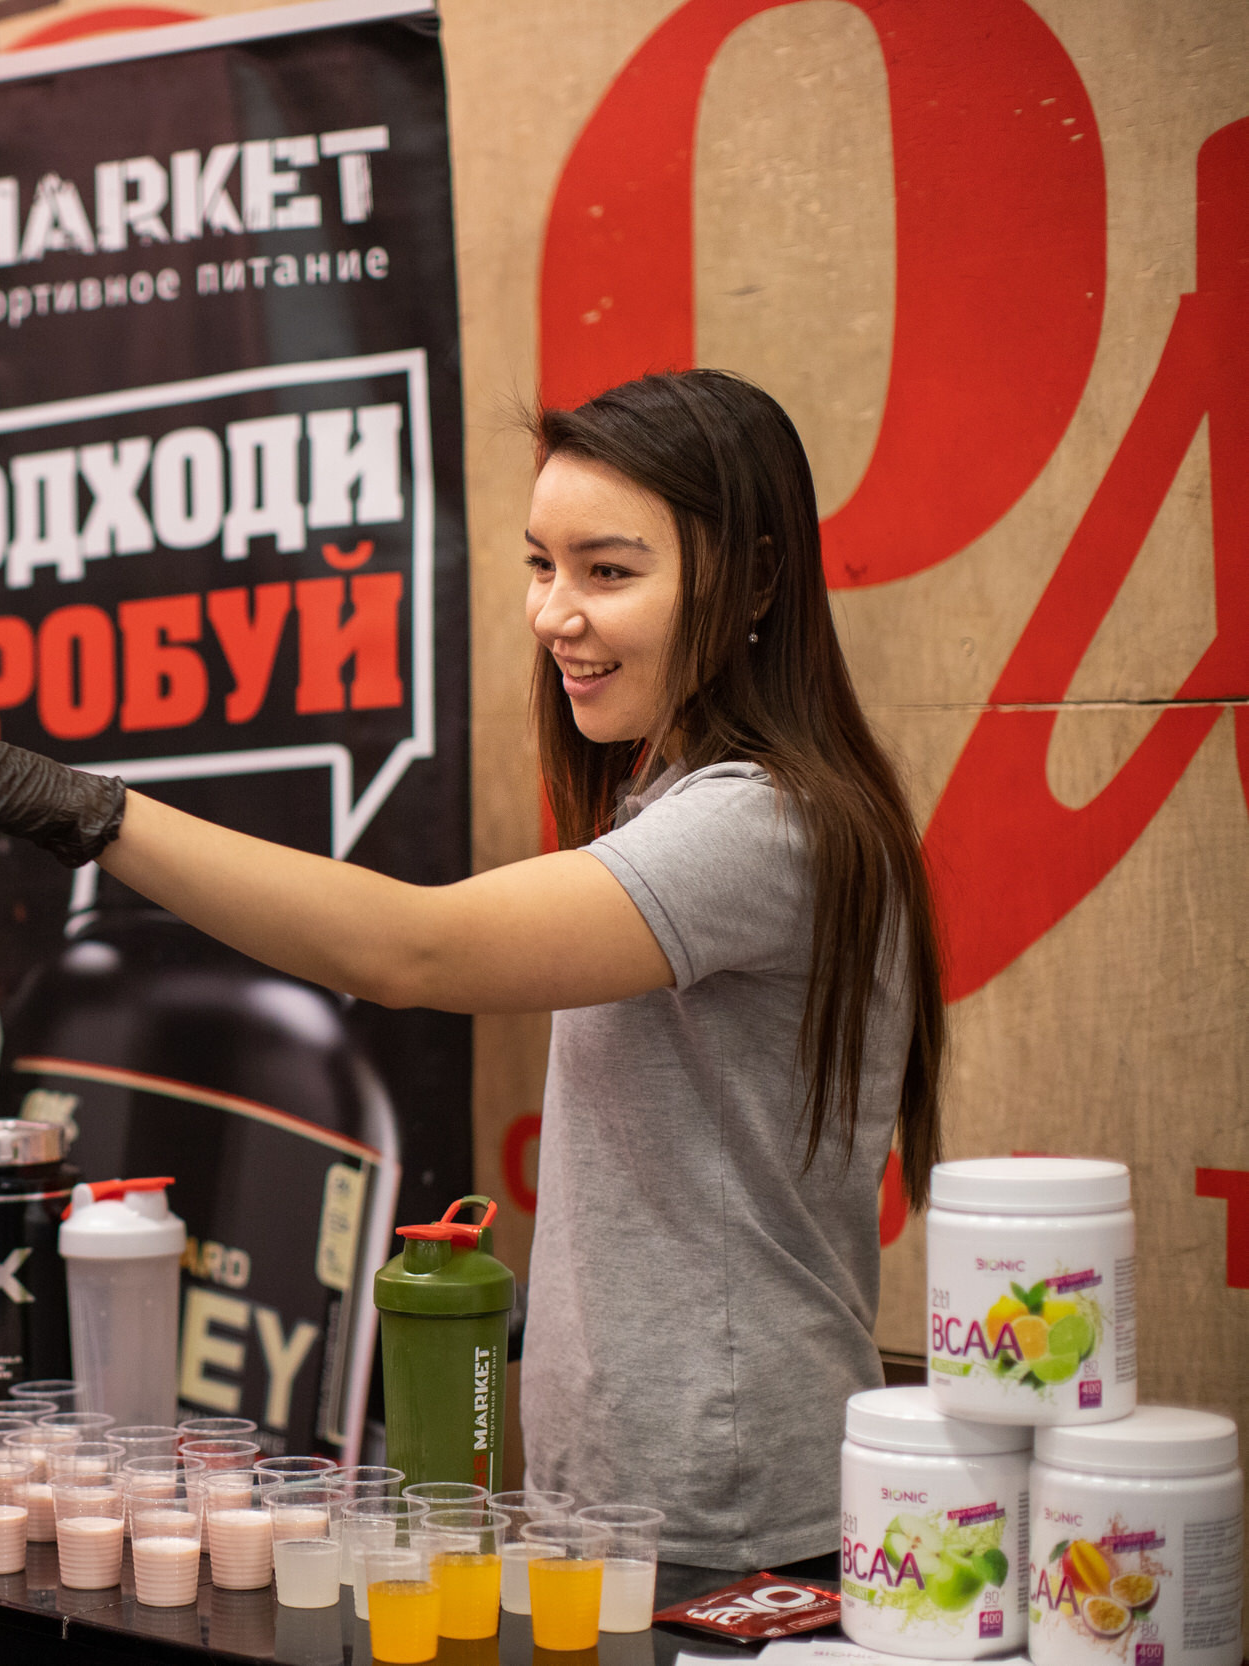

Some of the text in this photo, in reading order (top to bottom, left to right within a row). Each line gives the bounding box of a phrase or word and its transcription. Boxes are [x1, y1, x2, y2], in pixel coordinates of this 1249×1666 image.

[196, 246, 390, 296] питание
[931, 1313, 1025, 1361] BCAA
[473, 1346, 490, 1451] MARKET
[842, 1535, 925, 1591] BCAA
[1029, 1562, 1080, 1616] CAA
[981, 1613, 1002, 1625] 400
